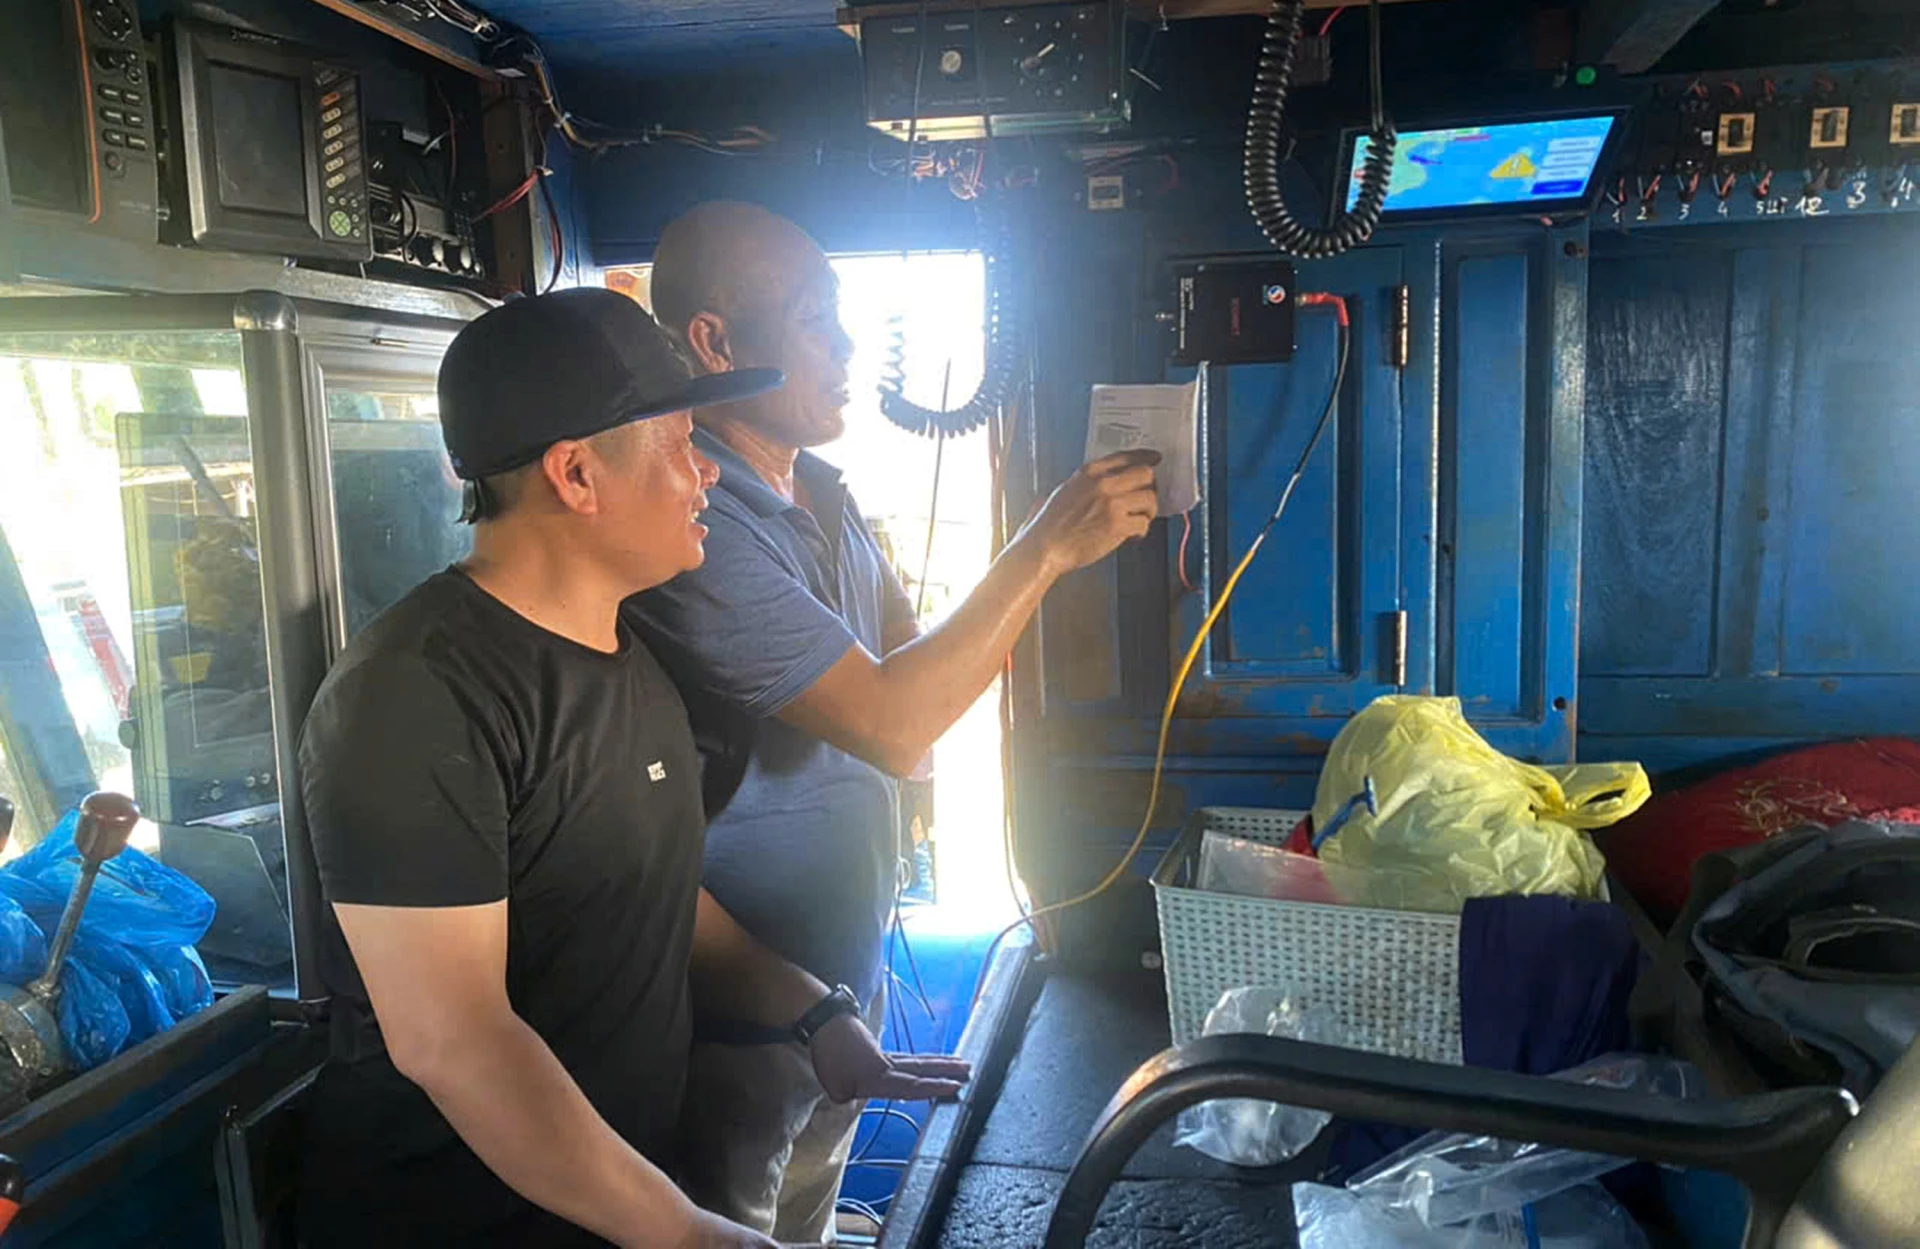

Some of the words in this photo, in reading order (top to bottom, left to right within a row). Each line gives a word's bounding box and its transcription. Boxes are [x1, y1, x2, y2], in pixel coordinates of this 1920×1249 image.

[1636, 205, 1648, 221] 2
[1679, 203, 1690, 221] 3
[1717, 200, 1728, 219] 4
